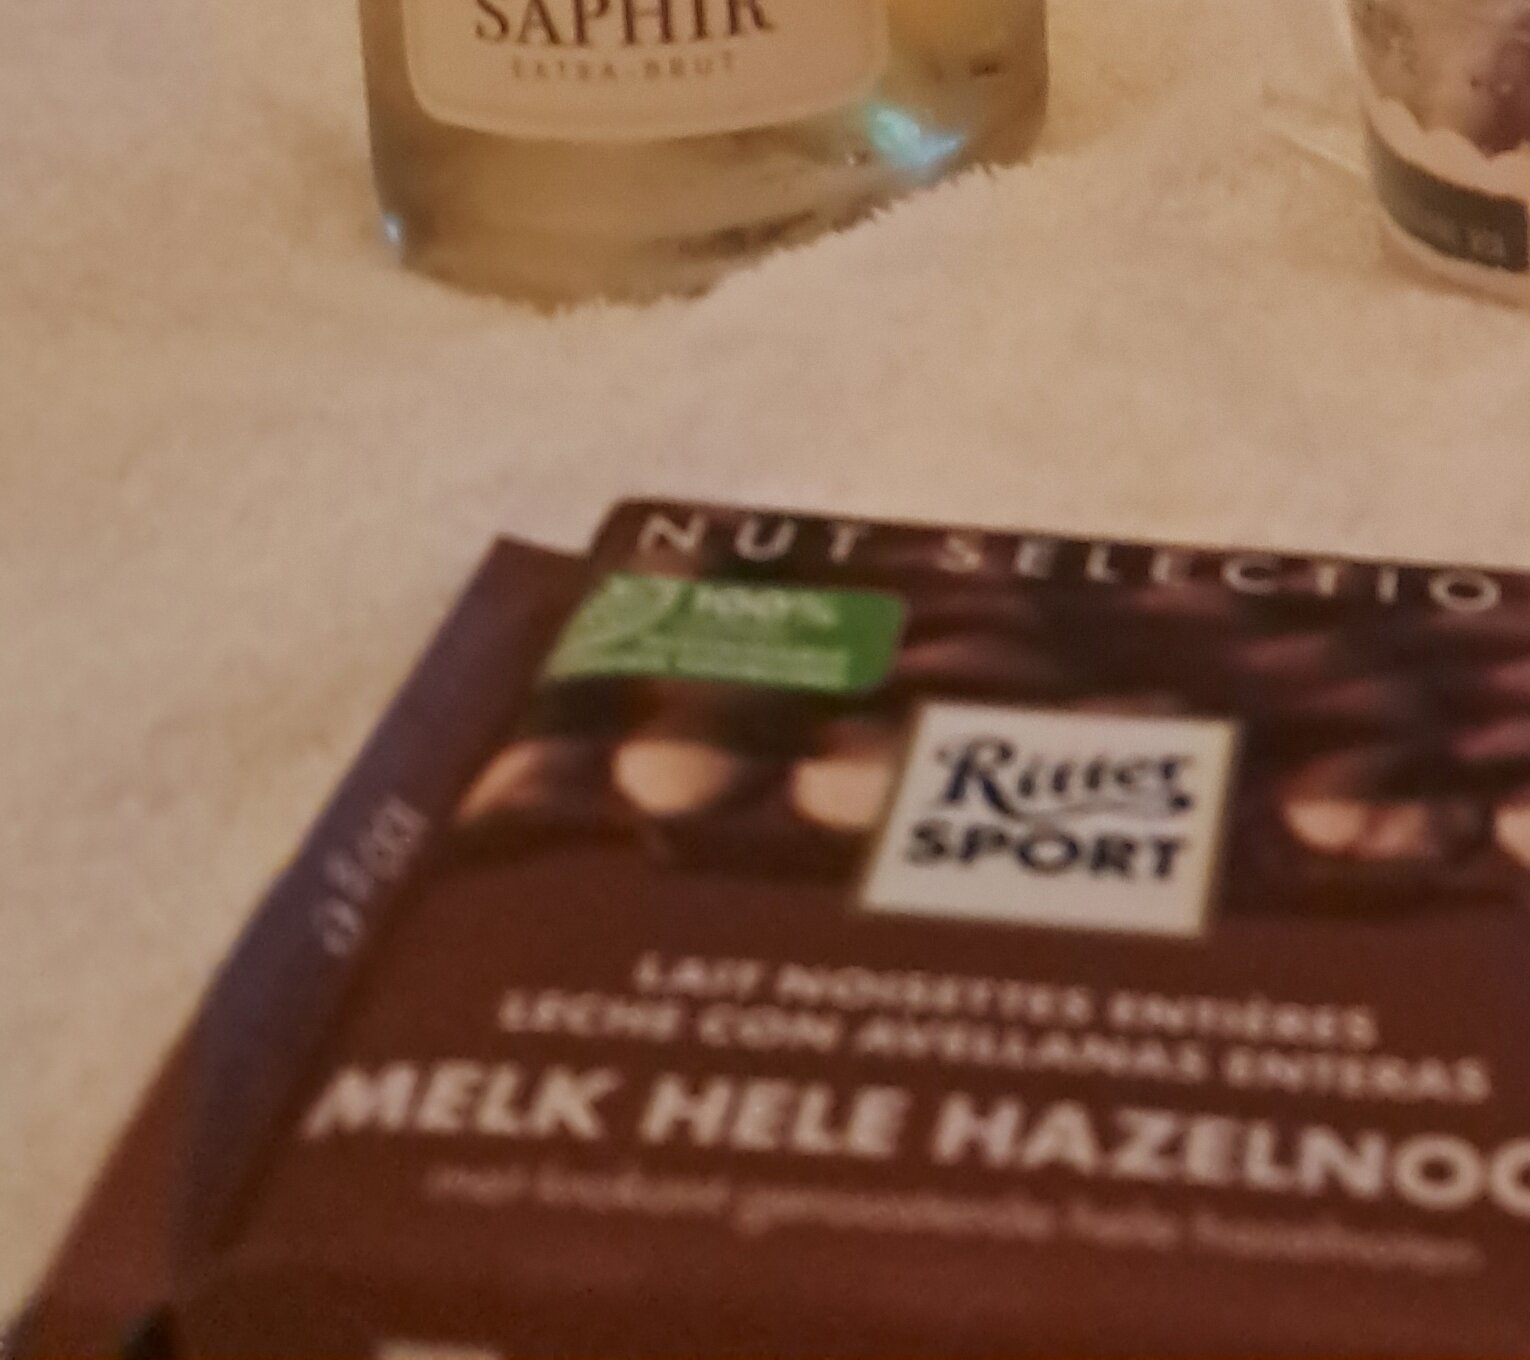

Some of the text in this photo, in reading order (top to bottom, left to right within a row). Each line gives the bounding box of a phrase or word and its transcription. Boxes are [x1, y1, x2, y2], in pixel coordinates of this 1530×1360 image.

[634, 511, 872, 564] NUT
[935, 738, 1196, 816] Ritter
[905, 818, 1188, 880] SPORT
[633, 952, 766, 997] LAIT
[777, 965, 1092, 1026] NOISETTES
[501, 990, 1490, 1104] LECHE CON AVELLANAS ENTERAS
[306, 1061, 622, 1140] MELK
[640, 1075, 906, 1160] HELE
